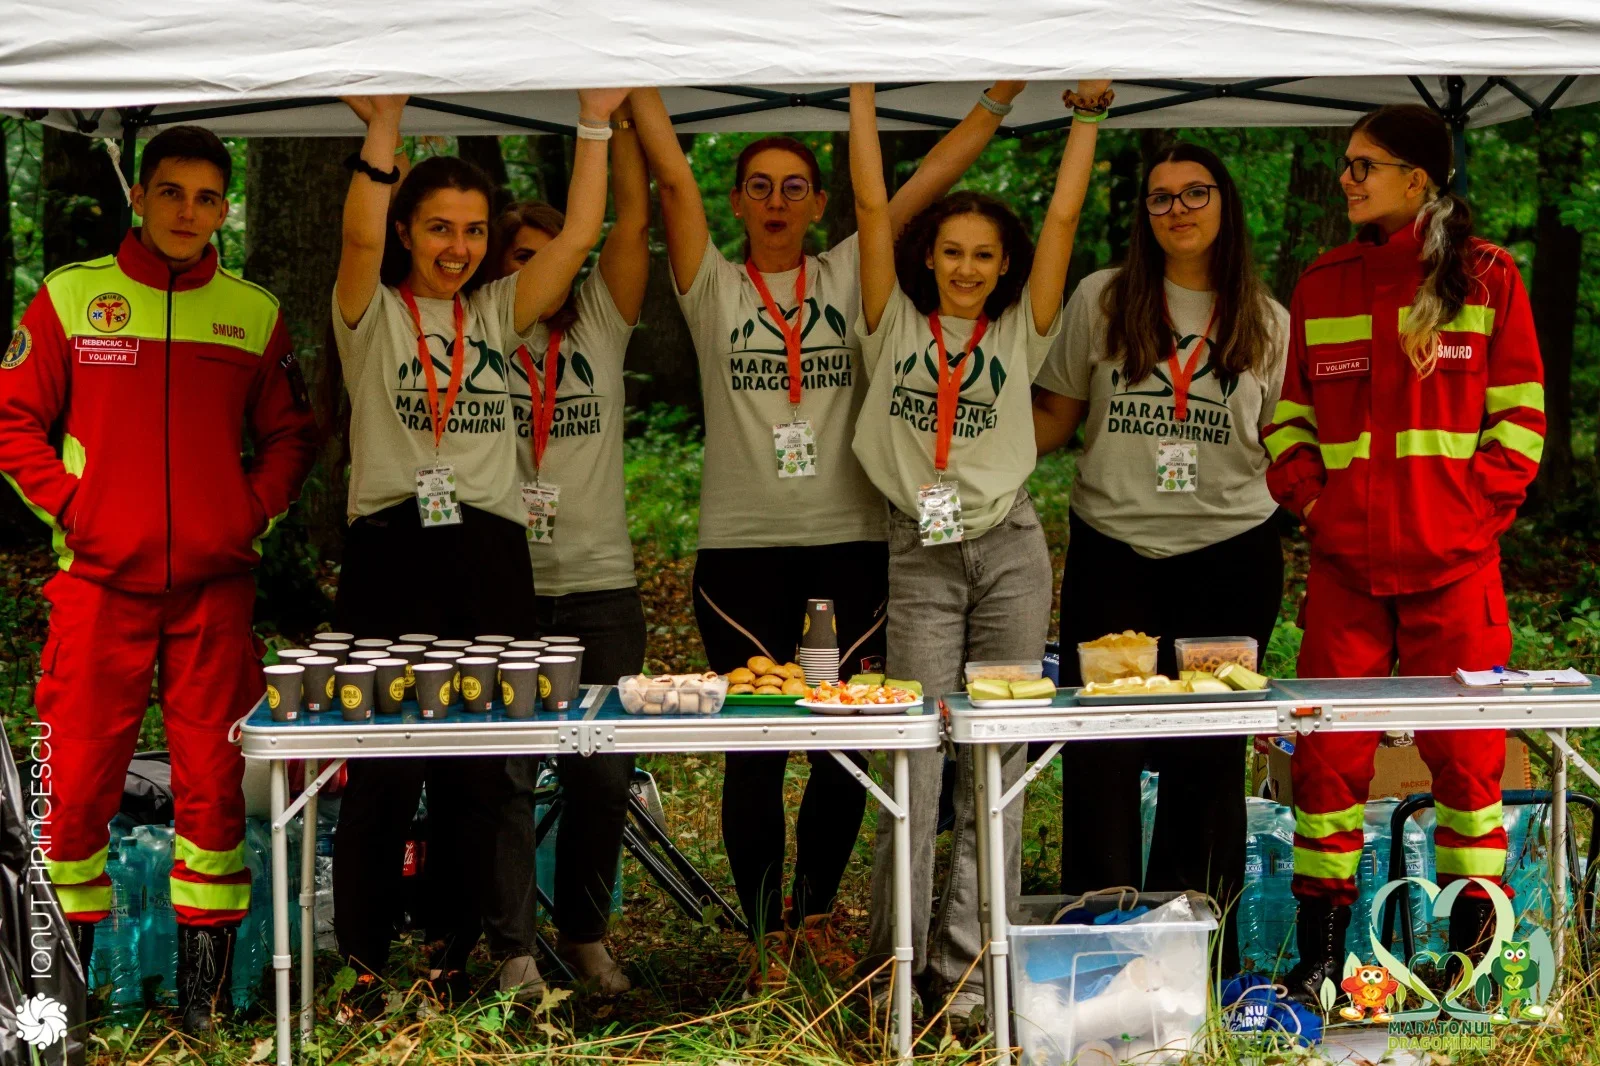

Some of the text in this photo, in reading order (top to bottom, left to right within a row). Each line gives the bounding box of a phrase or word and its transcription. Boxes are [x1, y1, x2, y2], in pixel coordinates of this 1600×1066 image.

[212, 322, 245, 340] SMURD
[82, 339, 123, 347] REBENCIUC
[88, 353, 127, 362] VOLUNTAR
[1437, 344, 1473, 360] SMURD
[730, 354, 852, 374] MARAONUL
[1325, 361, 1361, 373] VOLUNTAR
[1107, 417, 1231, 446] DRAGOMIRNEI
[1400, 780, 1430, 789] PACKER
